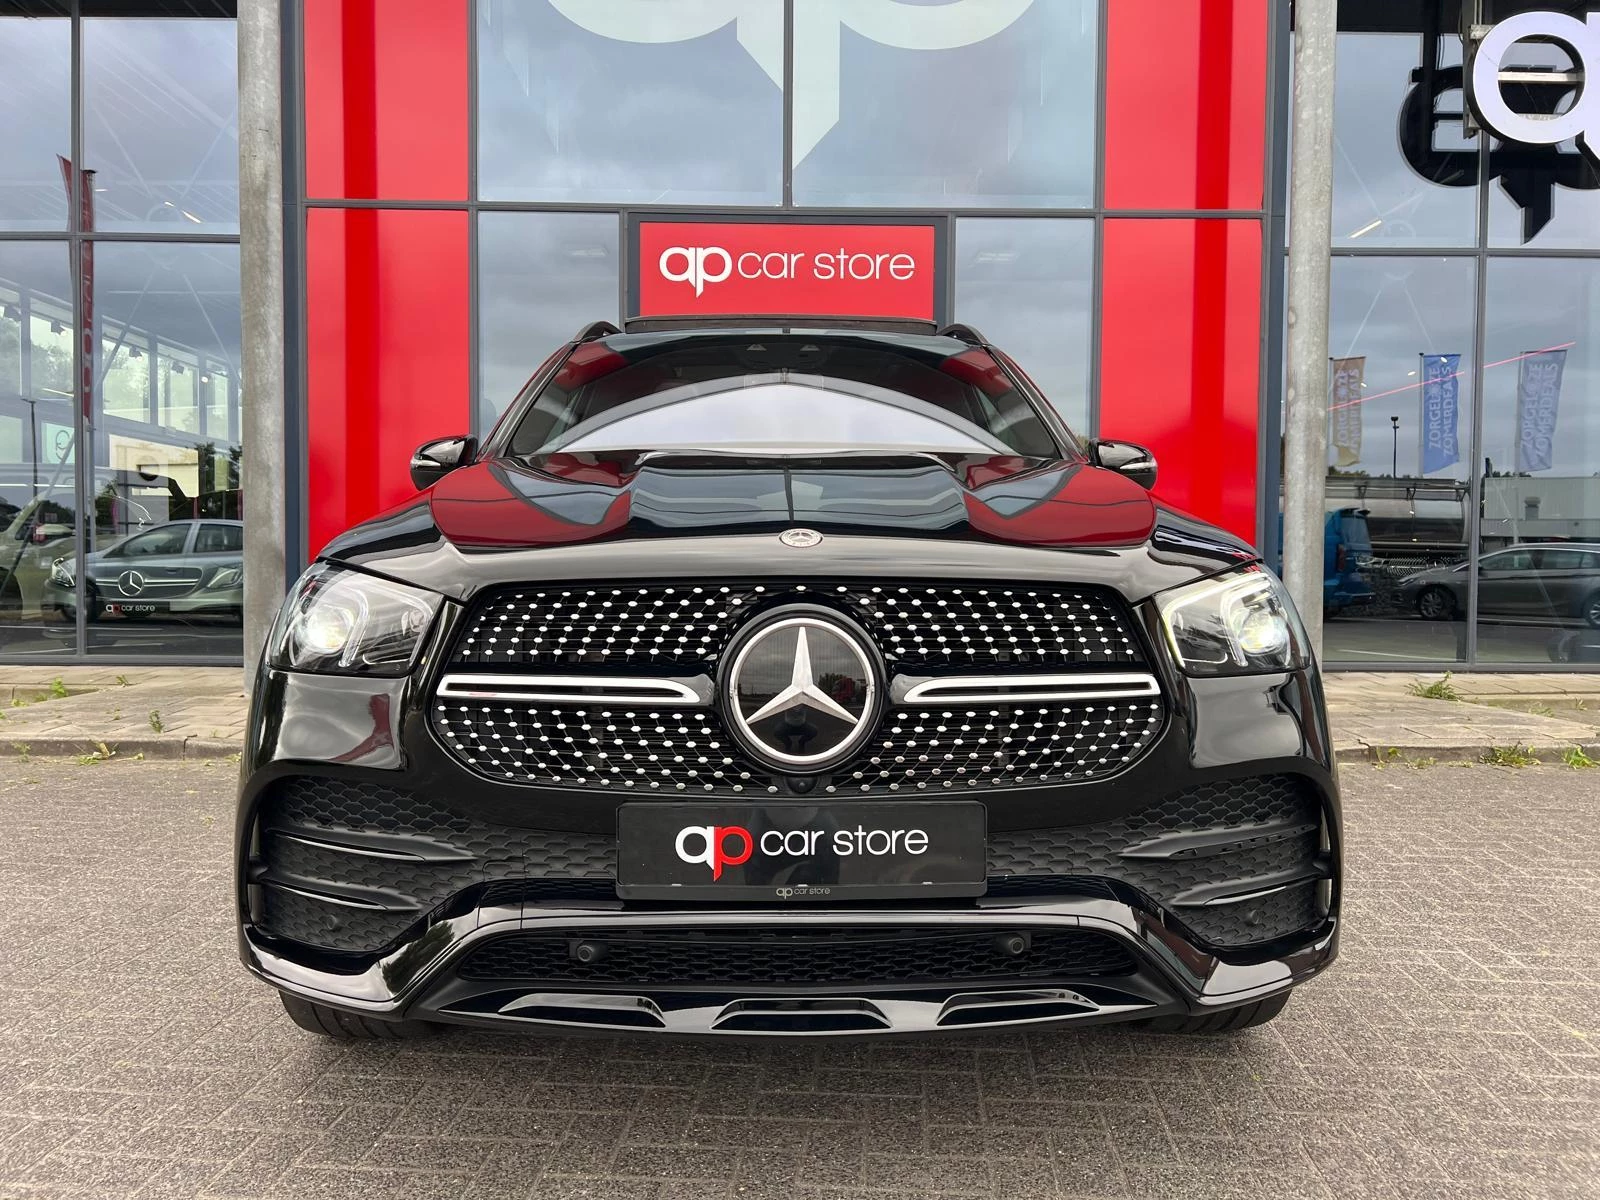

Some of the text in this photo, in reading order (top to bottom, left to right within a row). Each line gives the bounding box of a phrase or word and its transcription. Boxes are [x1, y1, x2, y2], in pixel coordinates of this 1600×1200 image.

[659, 246, 915, 299] ap car store
[121, 604, 133, 612] car
[135, 604, 156, 612] store
[675, 824, 929, 882] ap car store
[775, 887, 793, 900] ap
[808, 887, 831, 895] store
